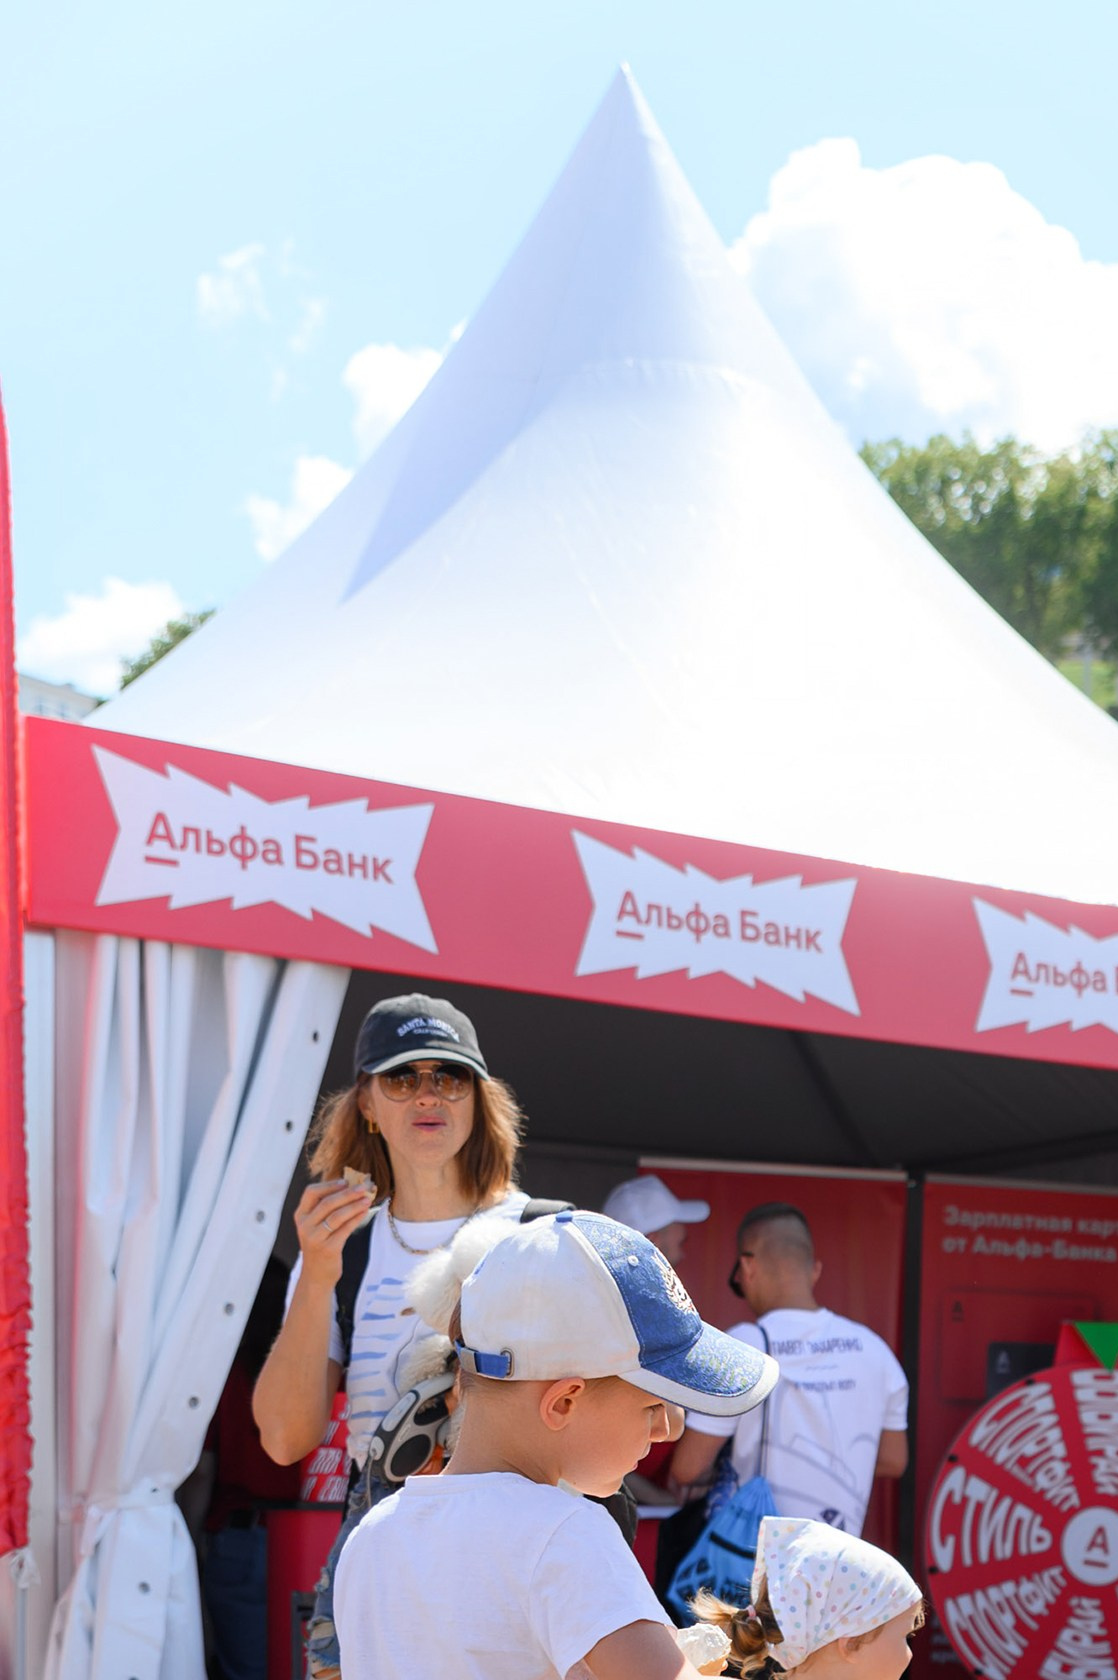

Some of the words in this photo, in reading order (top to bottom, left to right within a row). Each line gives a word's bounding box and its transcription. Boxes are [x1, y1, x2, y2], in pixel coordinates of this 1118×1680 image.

[144, 811, 284, 871] Альфа
[294, 833, 394, 884] Банк
[616, 890, 731, 943] Альфа
[739, 910, 823, 953] Банк
[1010, 952, 1108, 998] Альфа
[943, 1204, 1072, 1232] Зарплатная
[942, 1237, 966, 1254] от
[972, 1234, 1118, 1264] Альфа-Банка
[930, 1466, 1053, 1573] СТИЛЬ
